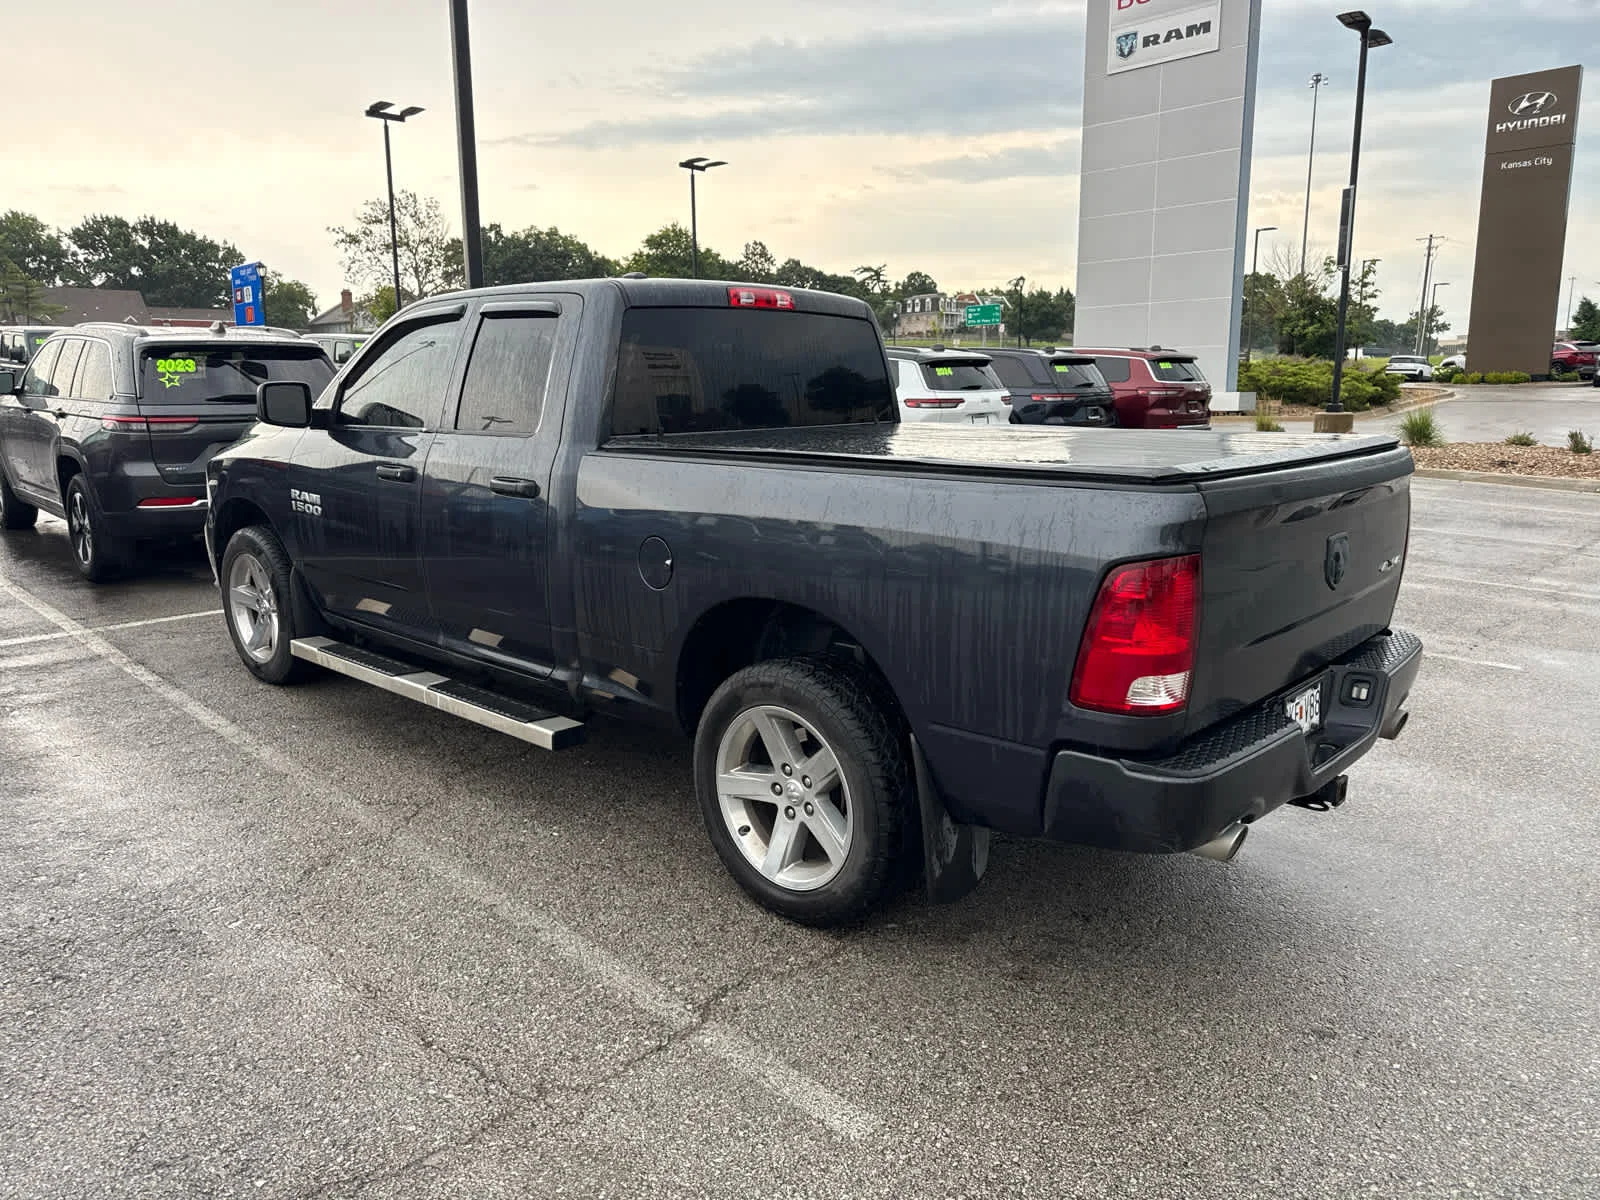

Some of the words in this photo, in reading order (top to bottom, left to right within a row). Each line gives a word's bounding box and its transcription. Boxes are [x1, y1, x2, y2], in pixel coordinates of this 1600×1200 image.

[1142, 21, 1212, 48] RAM
[1495, 113, 1567, 133] HYUNDAI
[1500, 160, 1532, 170] Kansas
[1534, 157, 1553, 166] City
[156, 358, 197, 373] 2023
[290, 488, 321, 505] RAM
[291, 500, 322, 516] 1500
